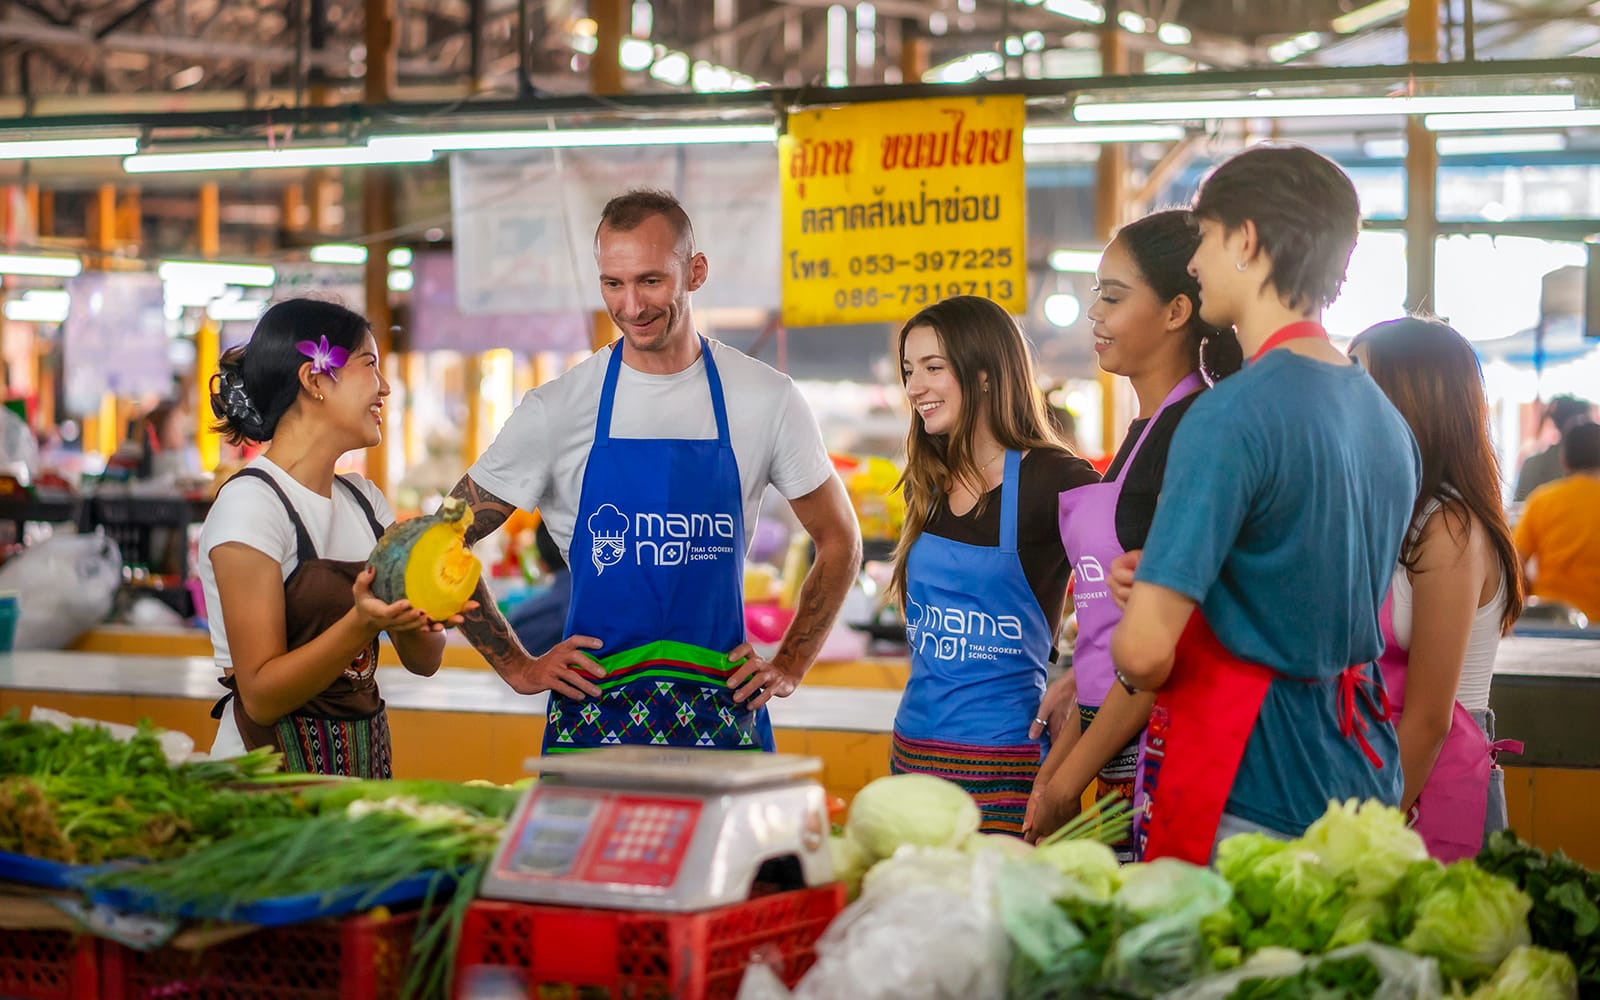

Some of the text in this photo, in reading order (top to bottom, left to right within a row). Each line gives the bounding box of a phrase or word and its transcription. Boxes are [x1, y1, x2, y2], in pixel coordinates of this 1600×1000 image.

[880, 108, 1013, 170] ขนมไทย
[849, 247, 1013, 276] 053-397225
[635, 512, 734, 538] mama
[925, 604, 1023, 640] mama
[968, 644, 1023, 655] THAI COOKERY
[968, 652, 998, 661] SCHOOL
